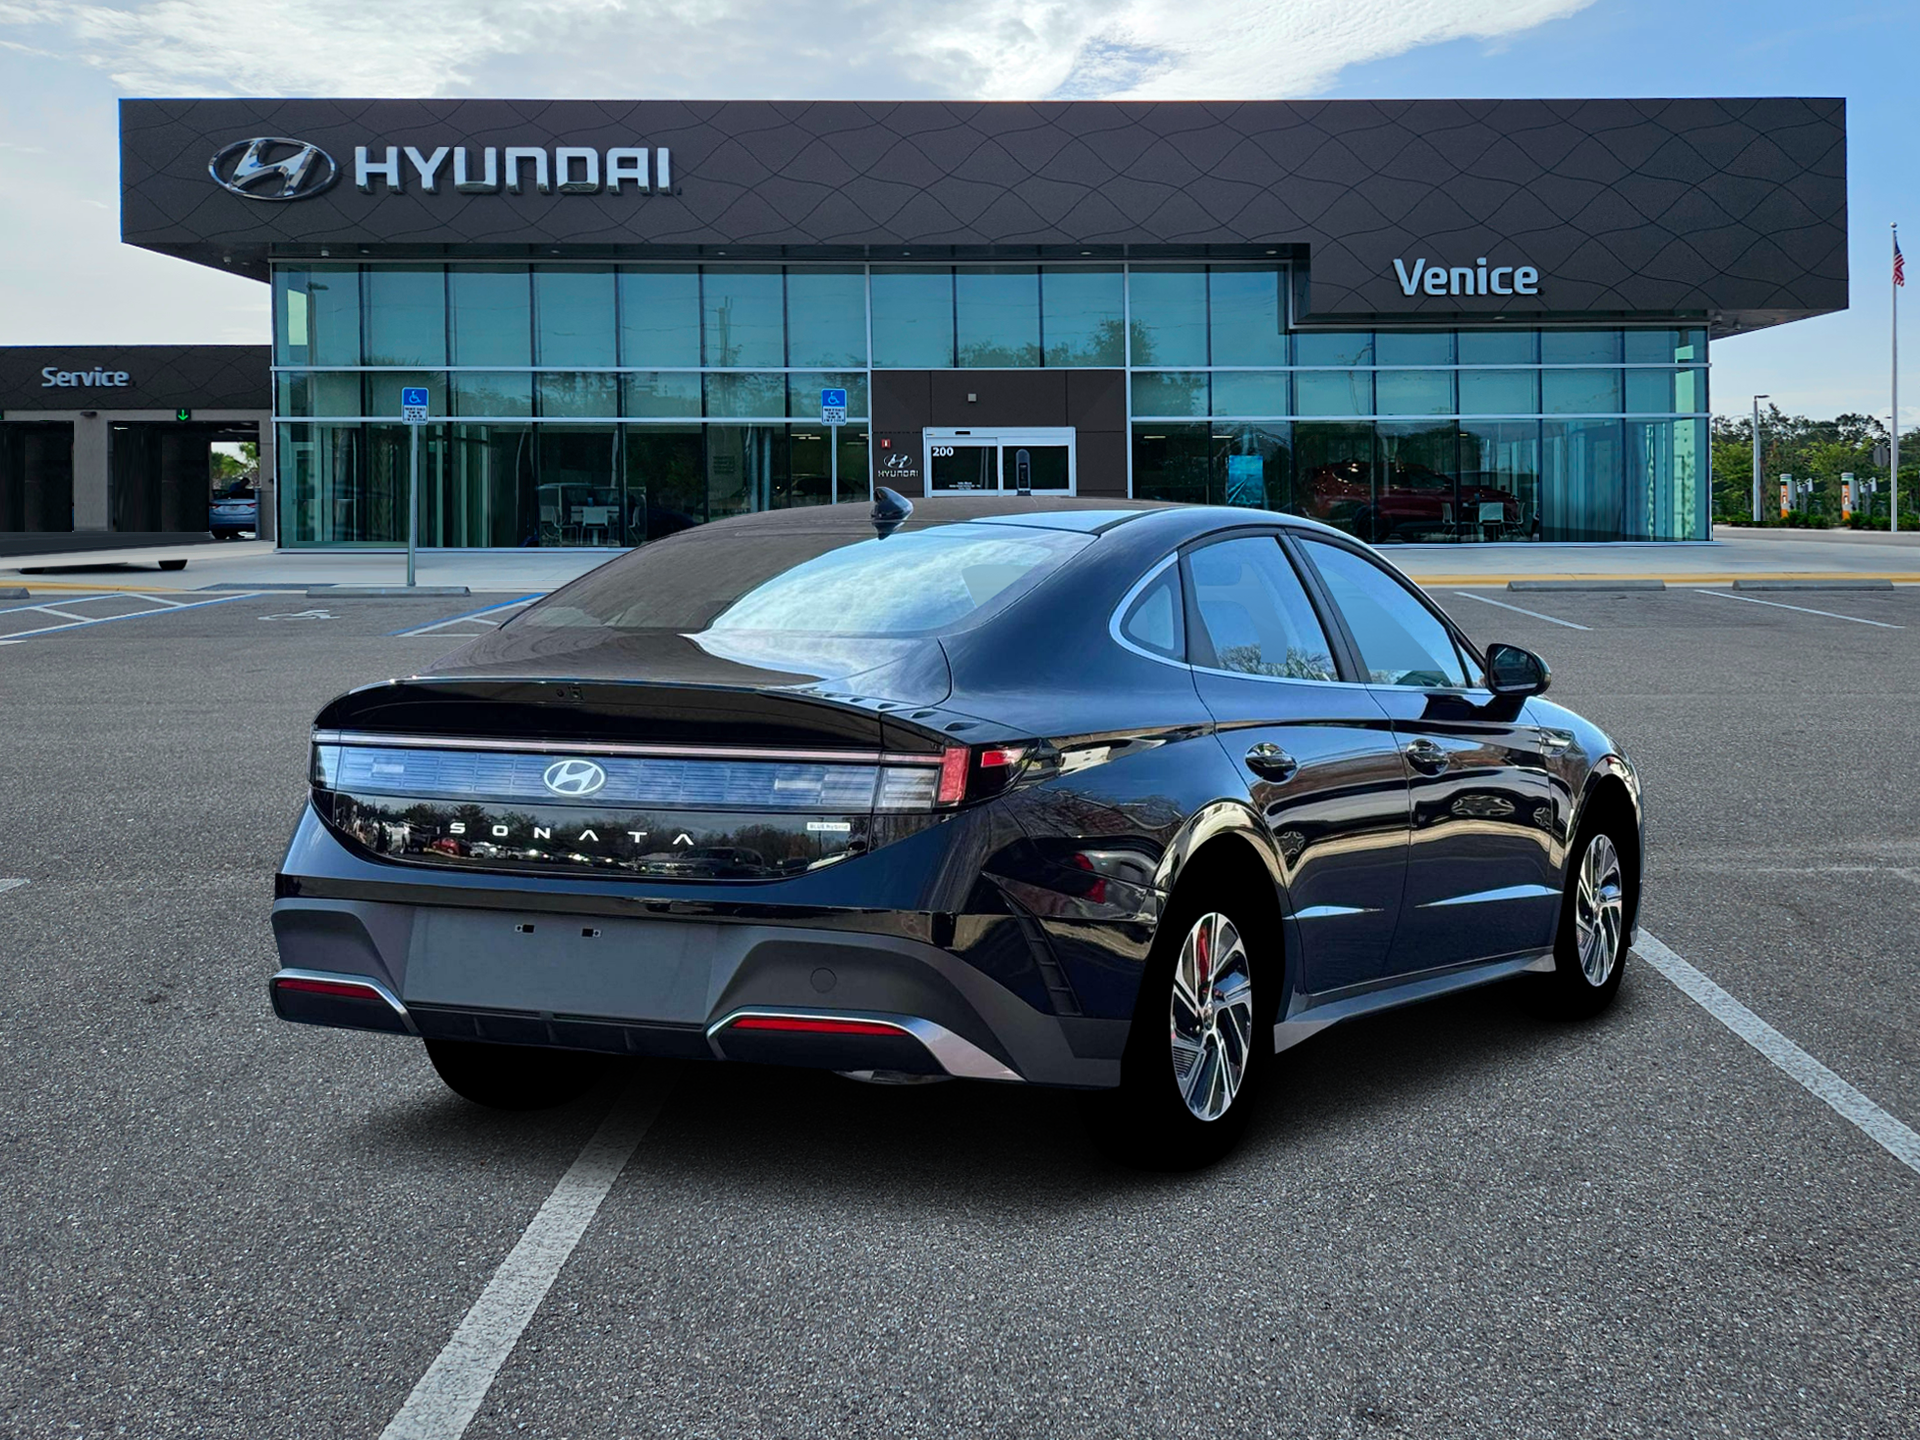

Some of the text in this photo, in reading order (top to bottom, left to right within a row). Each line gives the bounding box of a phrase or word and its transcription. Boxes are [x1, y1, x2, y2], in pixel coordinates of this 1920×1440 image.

[355, 146, 671, 193] HYUNDAI
[1393, 257, 1539, 296] Venice
[41, 367, 130, 387] Service
[932, 446, 954, 457] 200
[877, 470, 919, 478] HYUNDAI
[450, 822, 694, 846] SONATA
